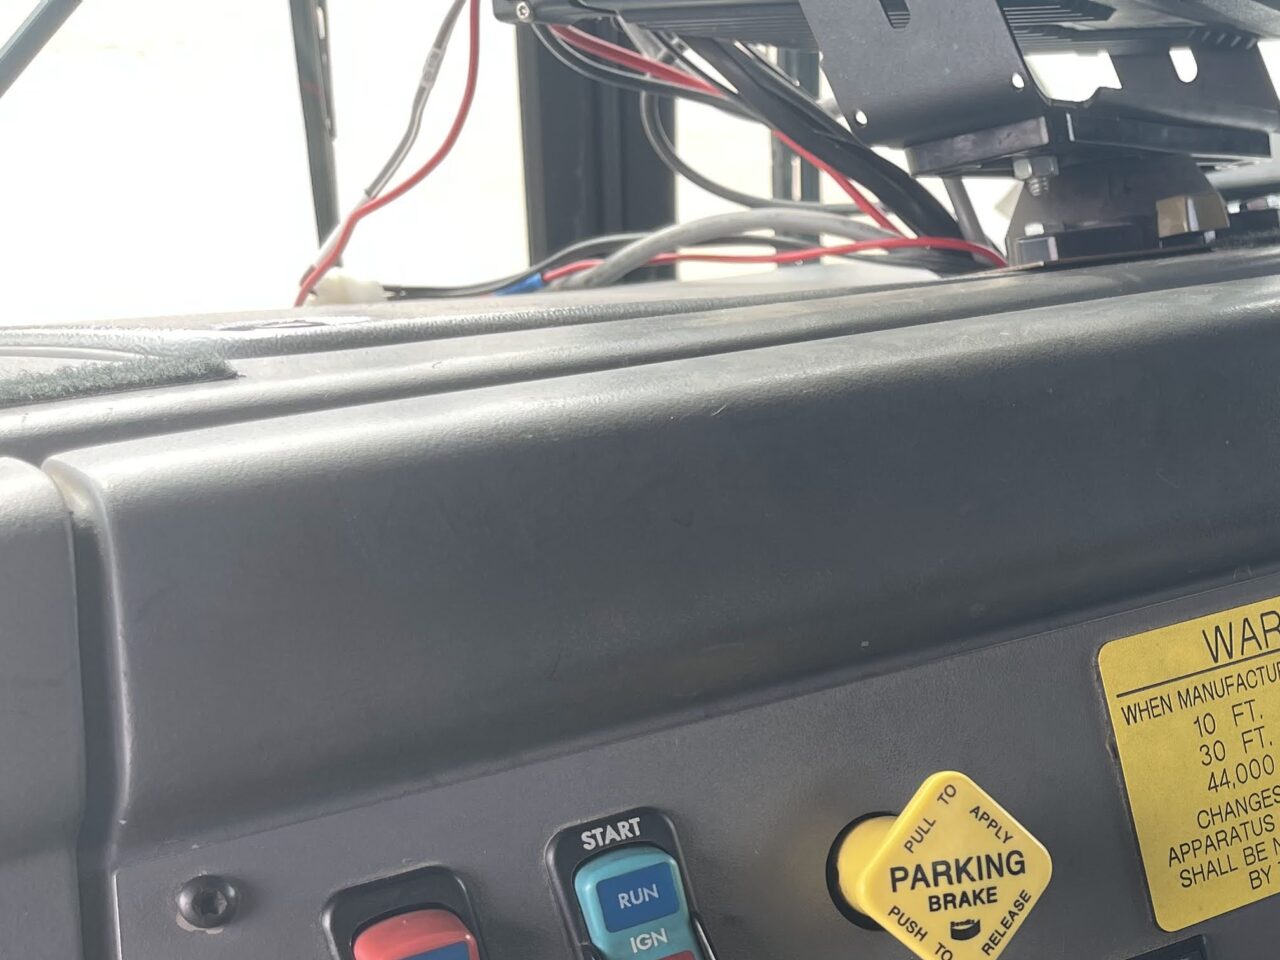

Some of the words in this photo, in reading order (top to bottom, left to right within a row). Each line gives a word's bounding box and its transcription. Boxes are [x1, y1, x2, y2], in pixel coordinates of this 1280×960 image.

[1121, 695, 1173, 726] WHEN
[1193, 712, 1216, 738] 10
[1232, 699, 1263, 726] FT.
[1199, 740, 1226, 767] 30
[1242, 729, 1273, 754] FT.
[1207, 755, 1276, 794] 44,000
[580, 817, 641, 851] START
[903, 818, 936, 854] PULL
[937, 784, 957, 805] TO
[969, 805, 1014, 845] APPLY
[1168, 813, 1275, 867] APPARATUS
[890, 850, 1026, 893] PARKING
[1180, 854, 1238, 889] SHALL
[1243, 842, 1267, 867] BE
[1249, 864, 1273, 891] BY
[617, 883, 660, 910] RUN
[928, 886, 998, 913] BRAKE
[629, 928, 670, 955] IGN
[888, 905, 928, 942] PUSH
[981, 889, 1032, 956] RELEASE
